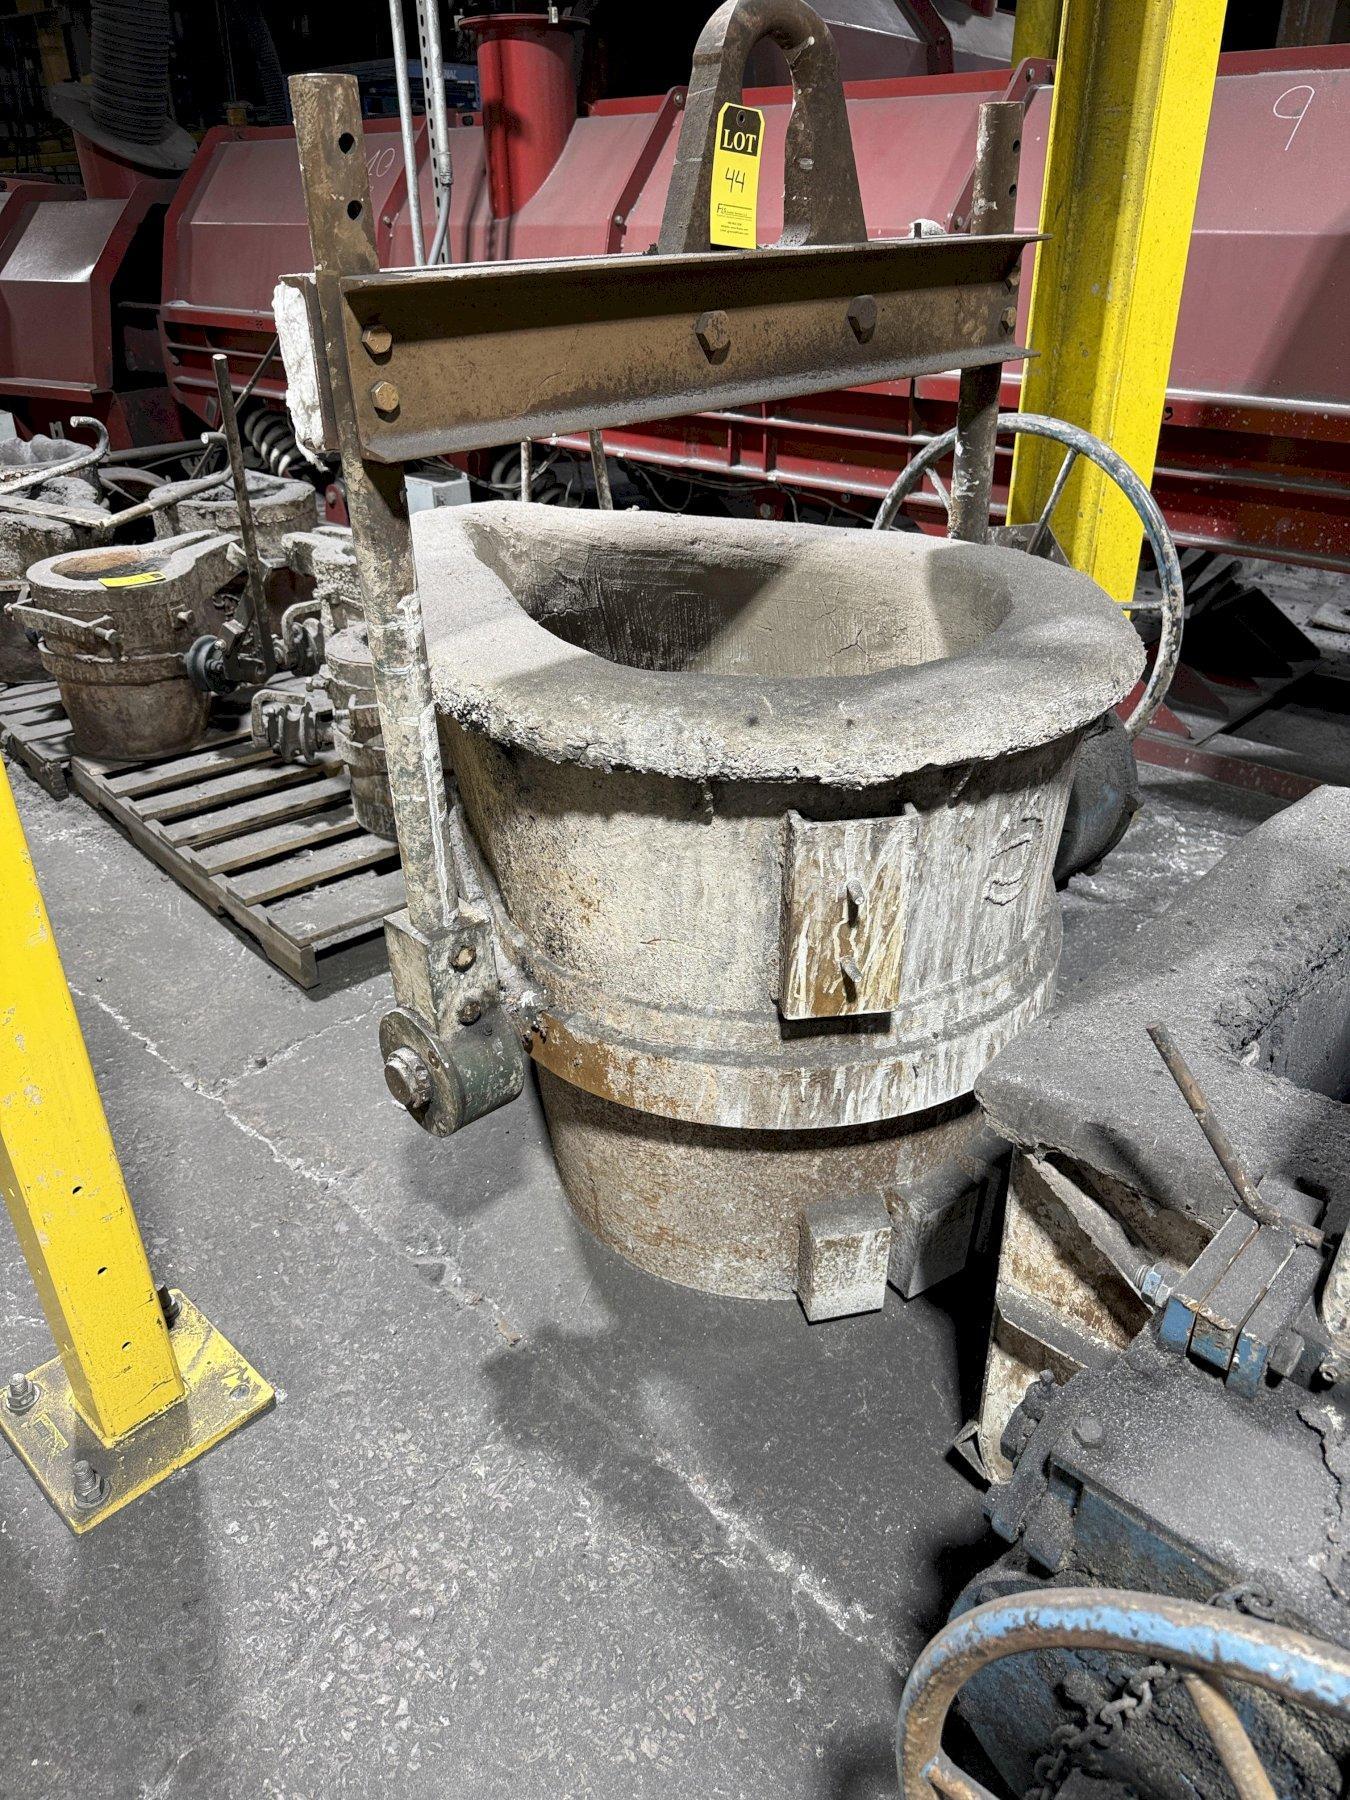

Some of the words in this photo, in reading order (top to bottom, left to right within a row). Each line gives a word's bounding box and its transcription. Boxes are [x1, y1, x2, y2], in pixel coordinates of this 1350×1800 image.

[1272, 85, 1315, 151] 9
[722, 128, 757, 153] LOT
[366, 147, 396, 178] 10
[724, 166, 746, 193] 44
